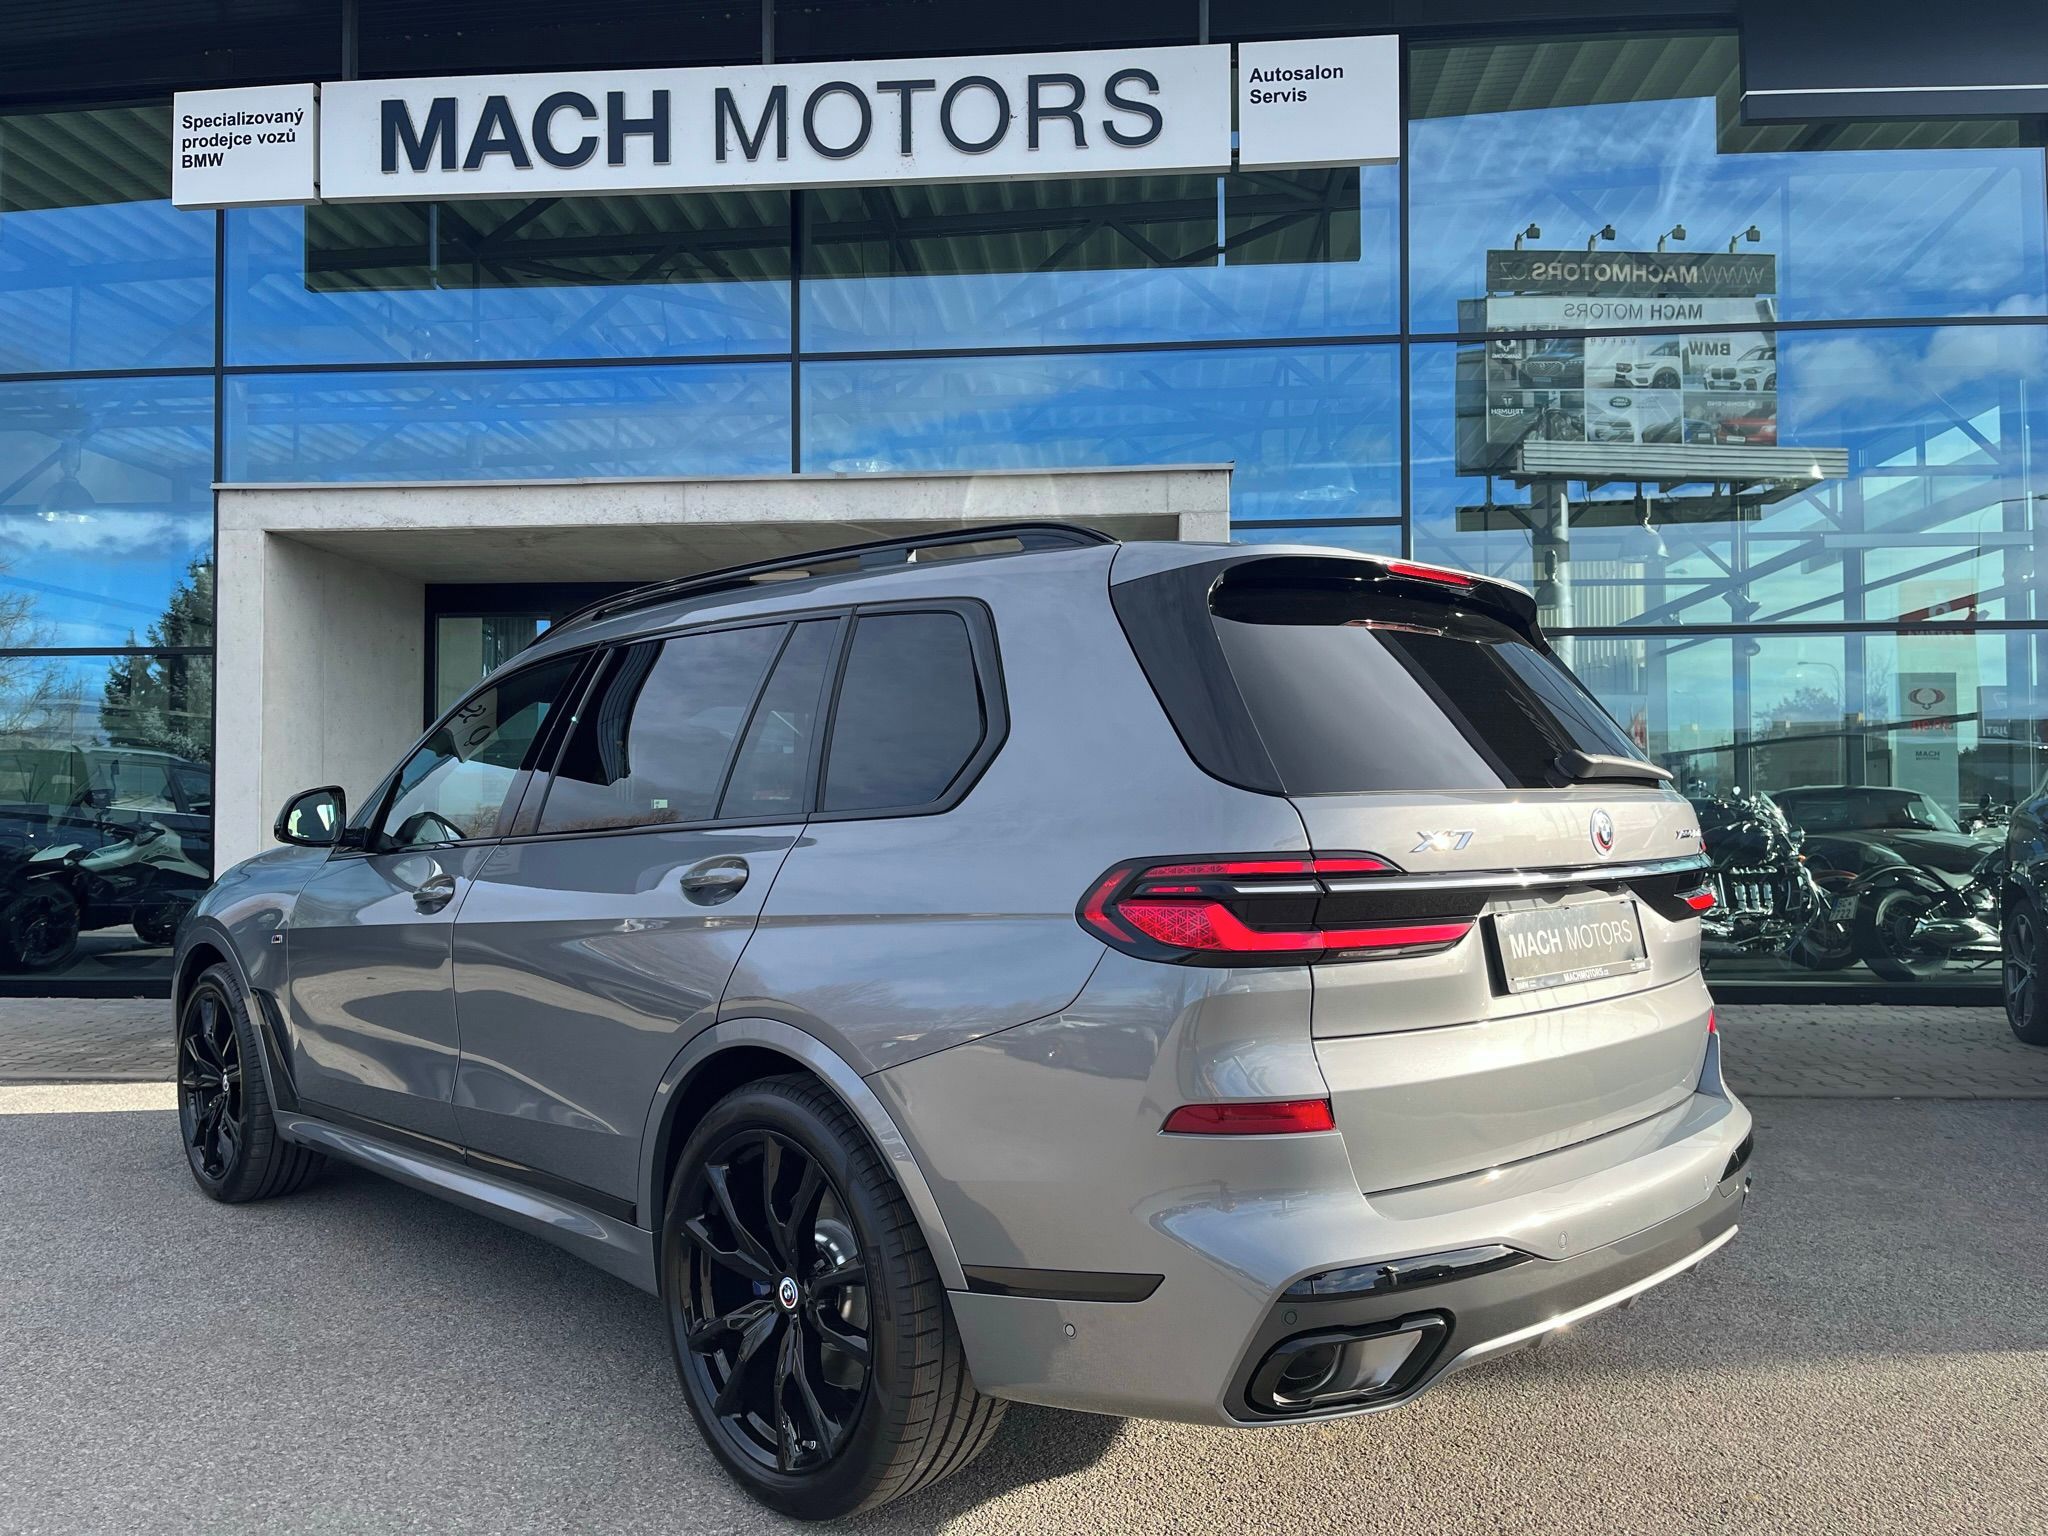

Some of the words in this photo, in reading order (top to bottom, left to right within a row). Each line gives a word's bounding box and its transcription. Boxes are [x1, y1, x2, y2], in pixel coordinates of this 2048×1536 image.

[1249, 64, 1344, 83] Autosalon
[1249, 87, 1308, 105] Servis
[182, 107, 304, 131] Specializovaný
[381, 89, 670, 175] MACH
[714, 67, 1163, 163] MOTORS
[182, 132, 252, 152] prodejce
[257, 127, 297, 146] vozů
[181, 152, 225, 169] BMW
[1409, 829, 1476, 853] X7
[1509, 929, 1563, 960] MACH
[1565, 919, 1633, 950] MOTORS
